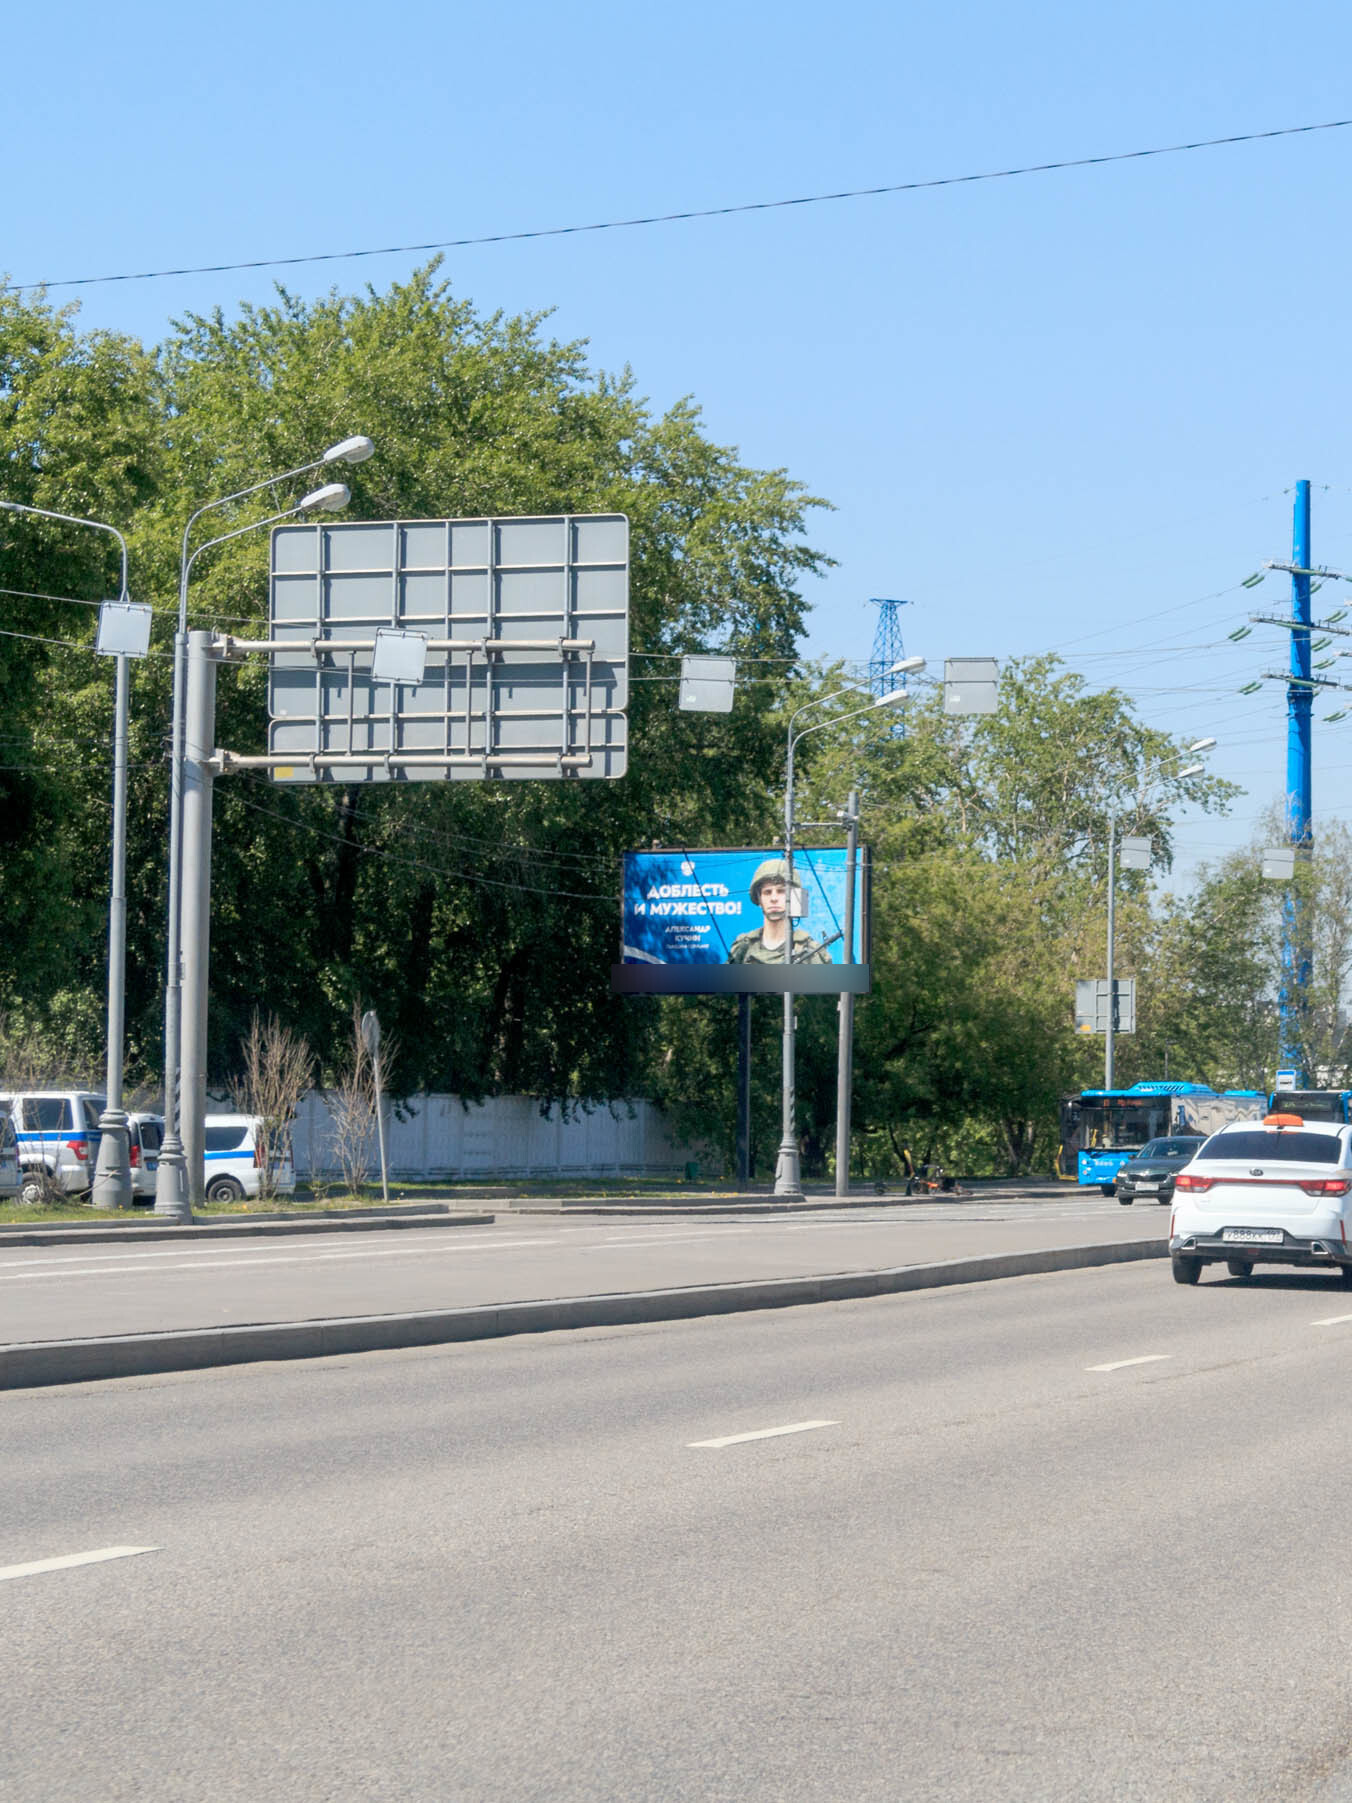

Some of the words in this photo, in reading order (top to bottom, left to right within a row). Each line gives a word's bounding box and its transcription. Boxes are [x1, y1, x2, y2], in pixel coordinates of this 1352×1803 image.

[647, 884, 729, 899] ДОБЛЕСТЬ
[634, 903, 646, 916] И
[650, 901, 742, 916] МУЖЕСТВО!
